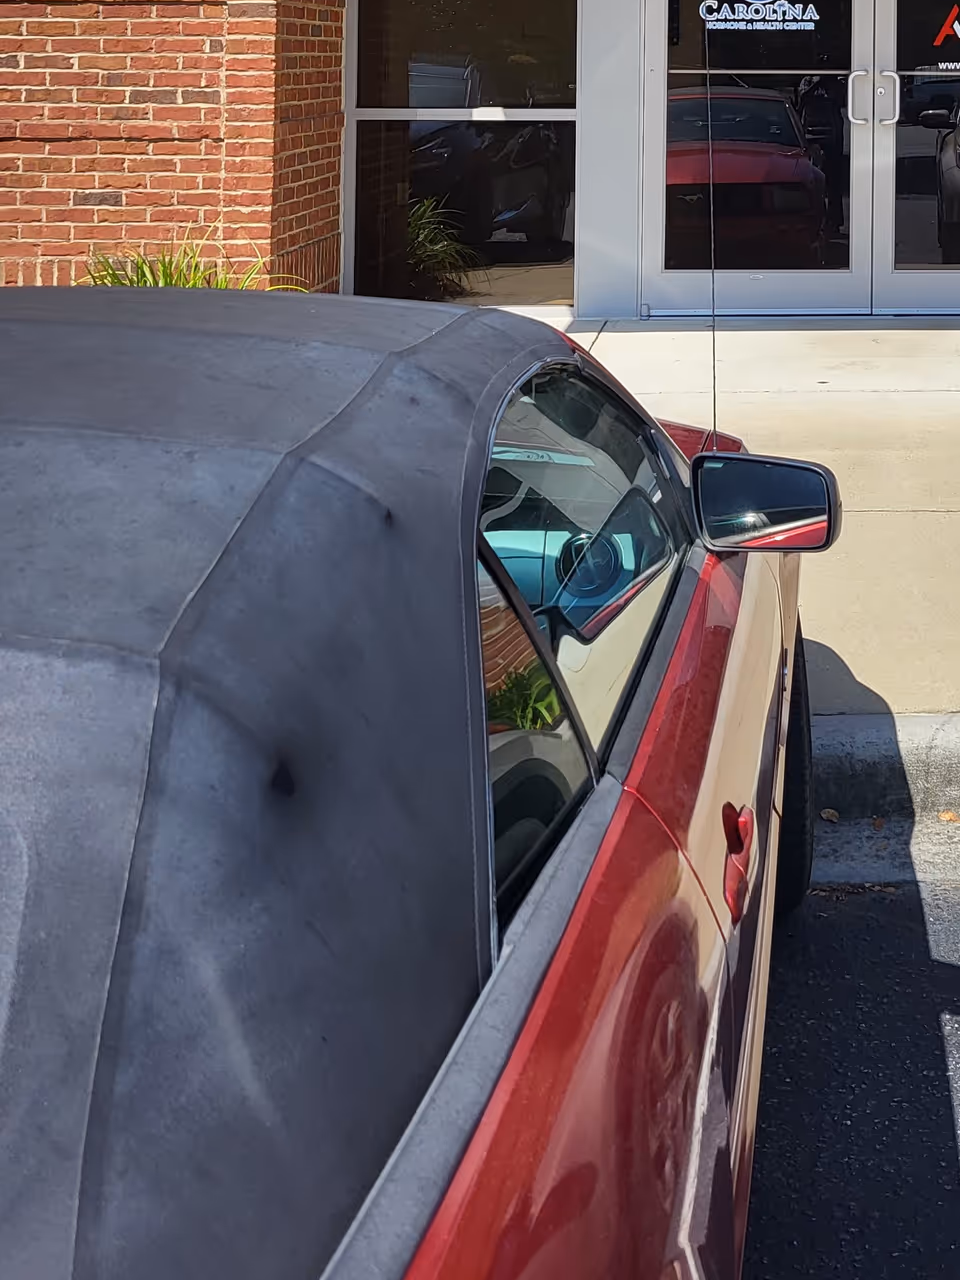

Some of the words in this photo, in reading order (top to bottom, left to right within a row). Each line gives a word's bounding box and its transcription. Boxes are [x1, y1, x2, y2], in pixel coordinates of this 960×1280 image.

[699, 0, 819, 20] CAROLINA
[753, 22, 783, 30] HEALTH
[784, 22, 815, 30] CENTER
